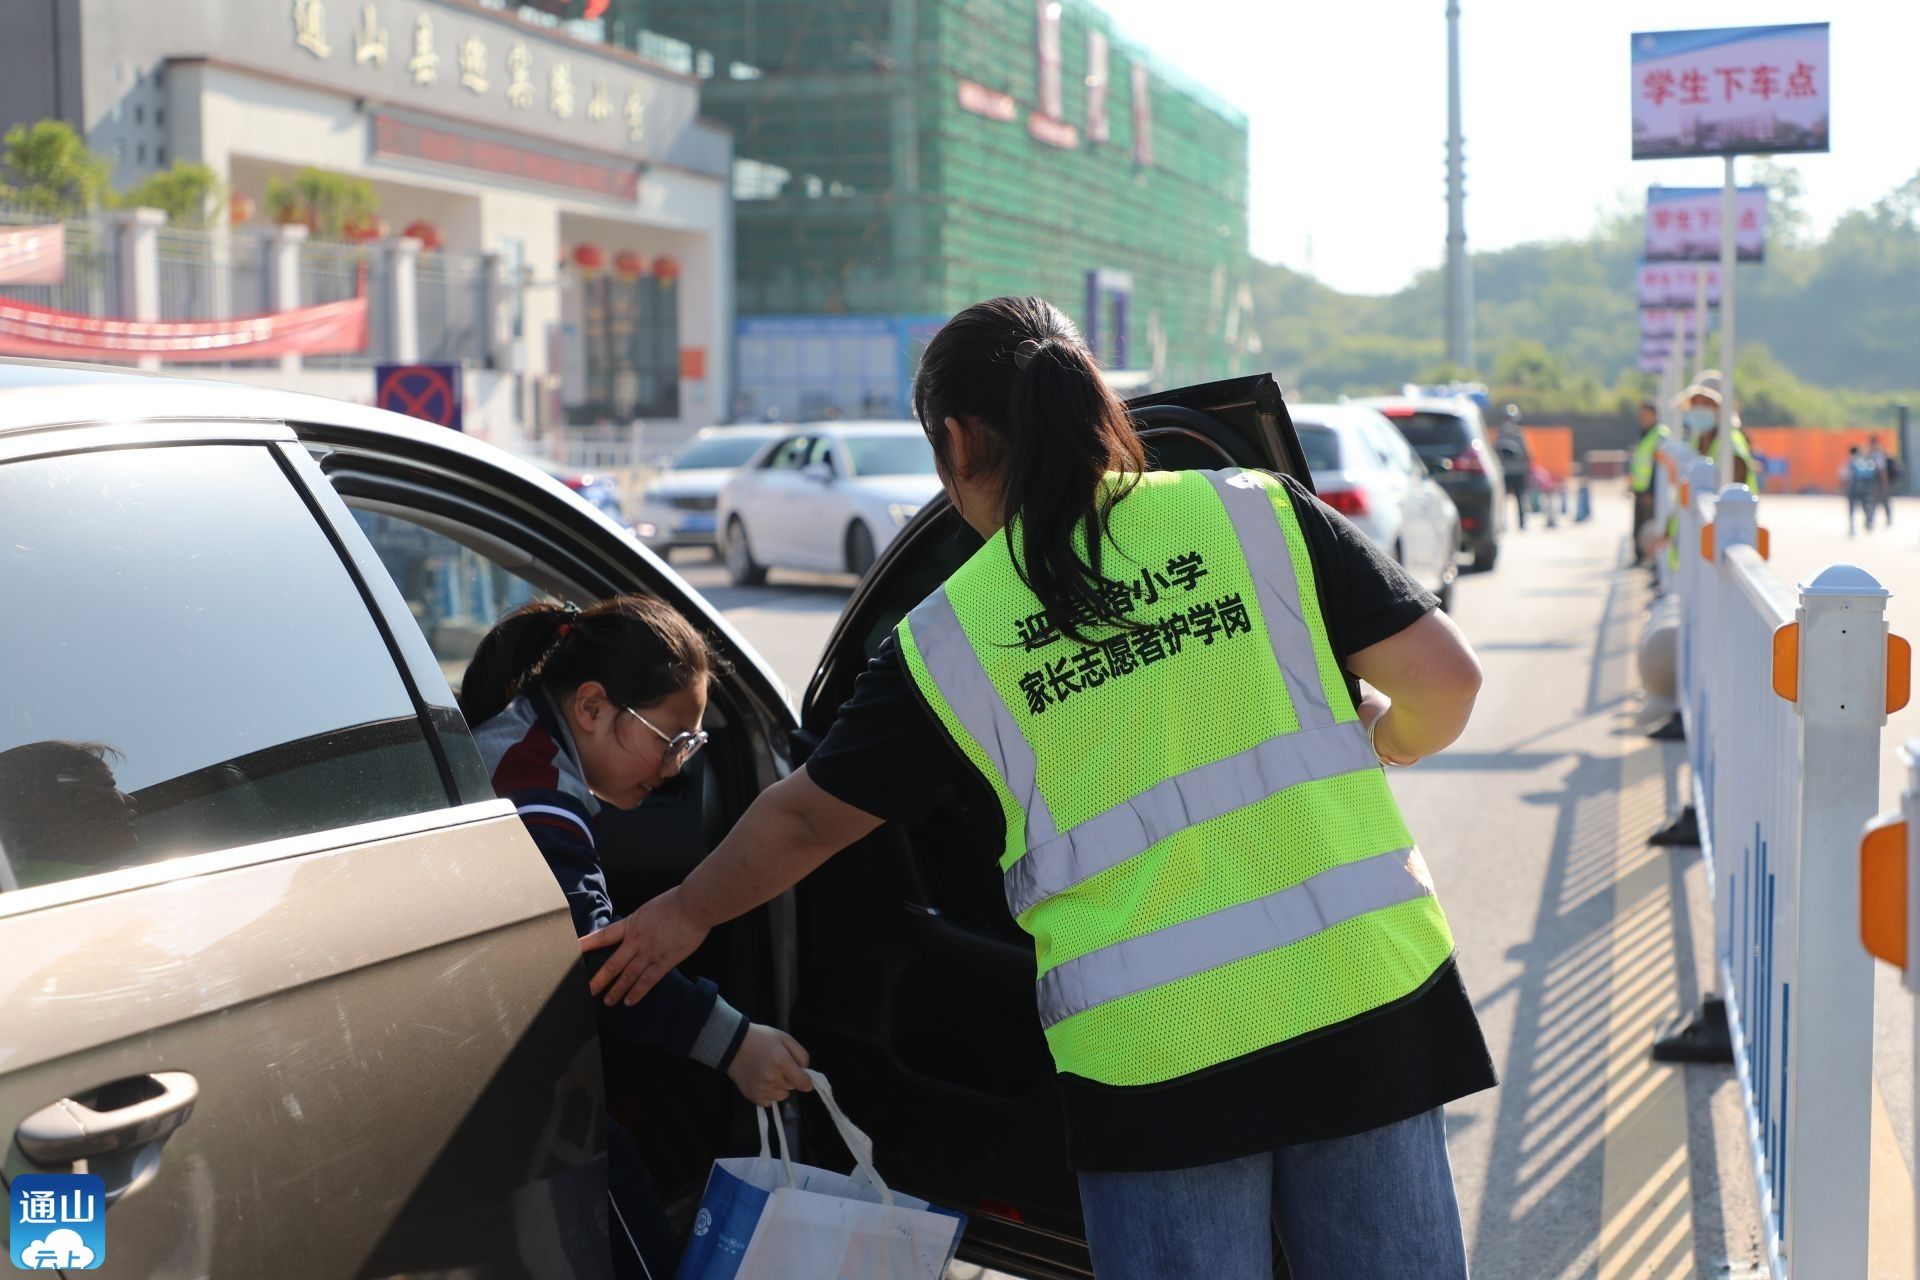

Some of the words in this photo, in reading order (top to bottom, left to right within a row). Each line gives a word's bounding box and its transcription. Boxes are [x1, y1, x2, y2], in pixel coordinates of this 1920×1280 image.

[1643, 61, 1818, 106] 学生下车点
[1653, 207, 1759, 232] 学生下点
[1014, 551, 1208, 653] 迎路小学
[1018, 592, 1252, 716] 家长志愿者护学岗
